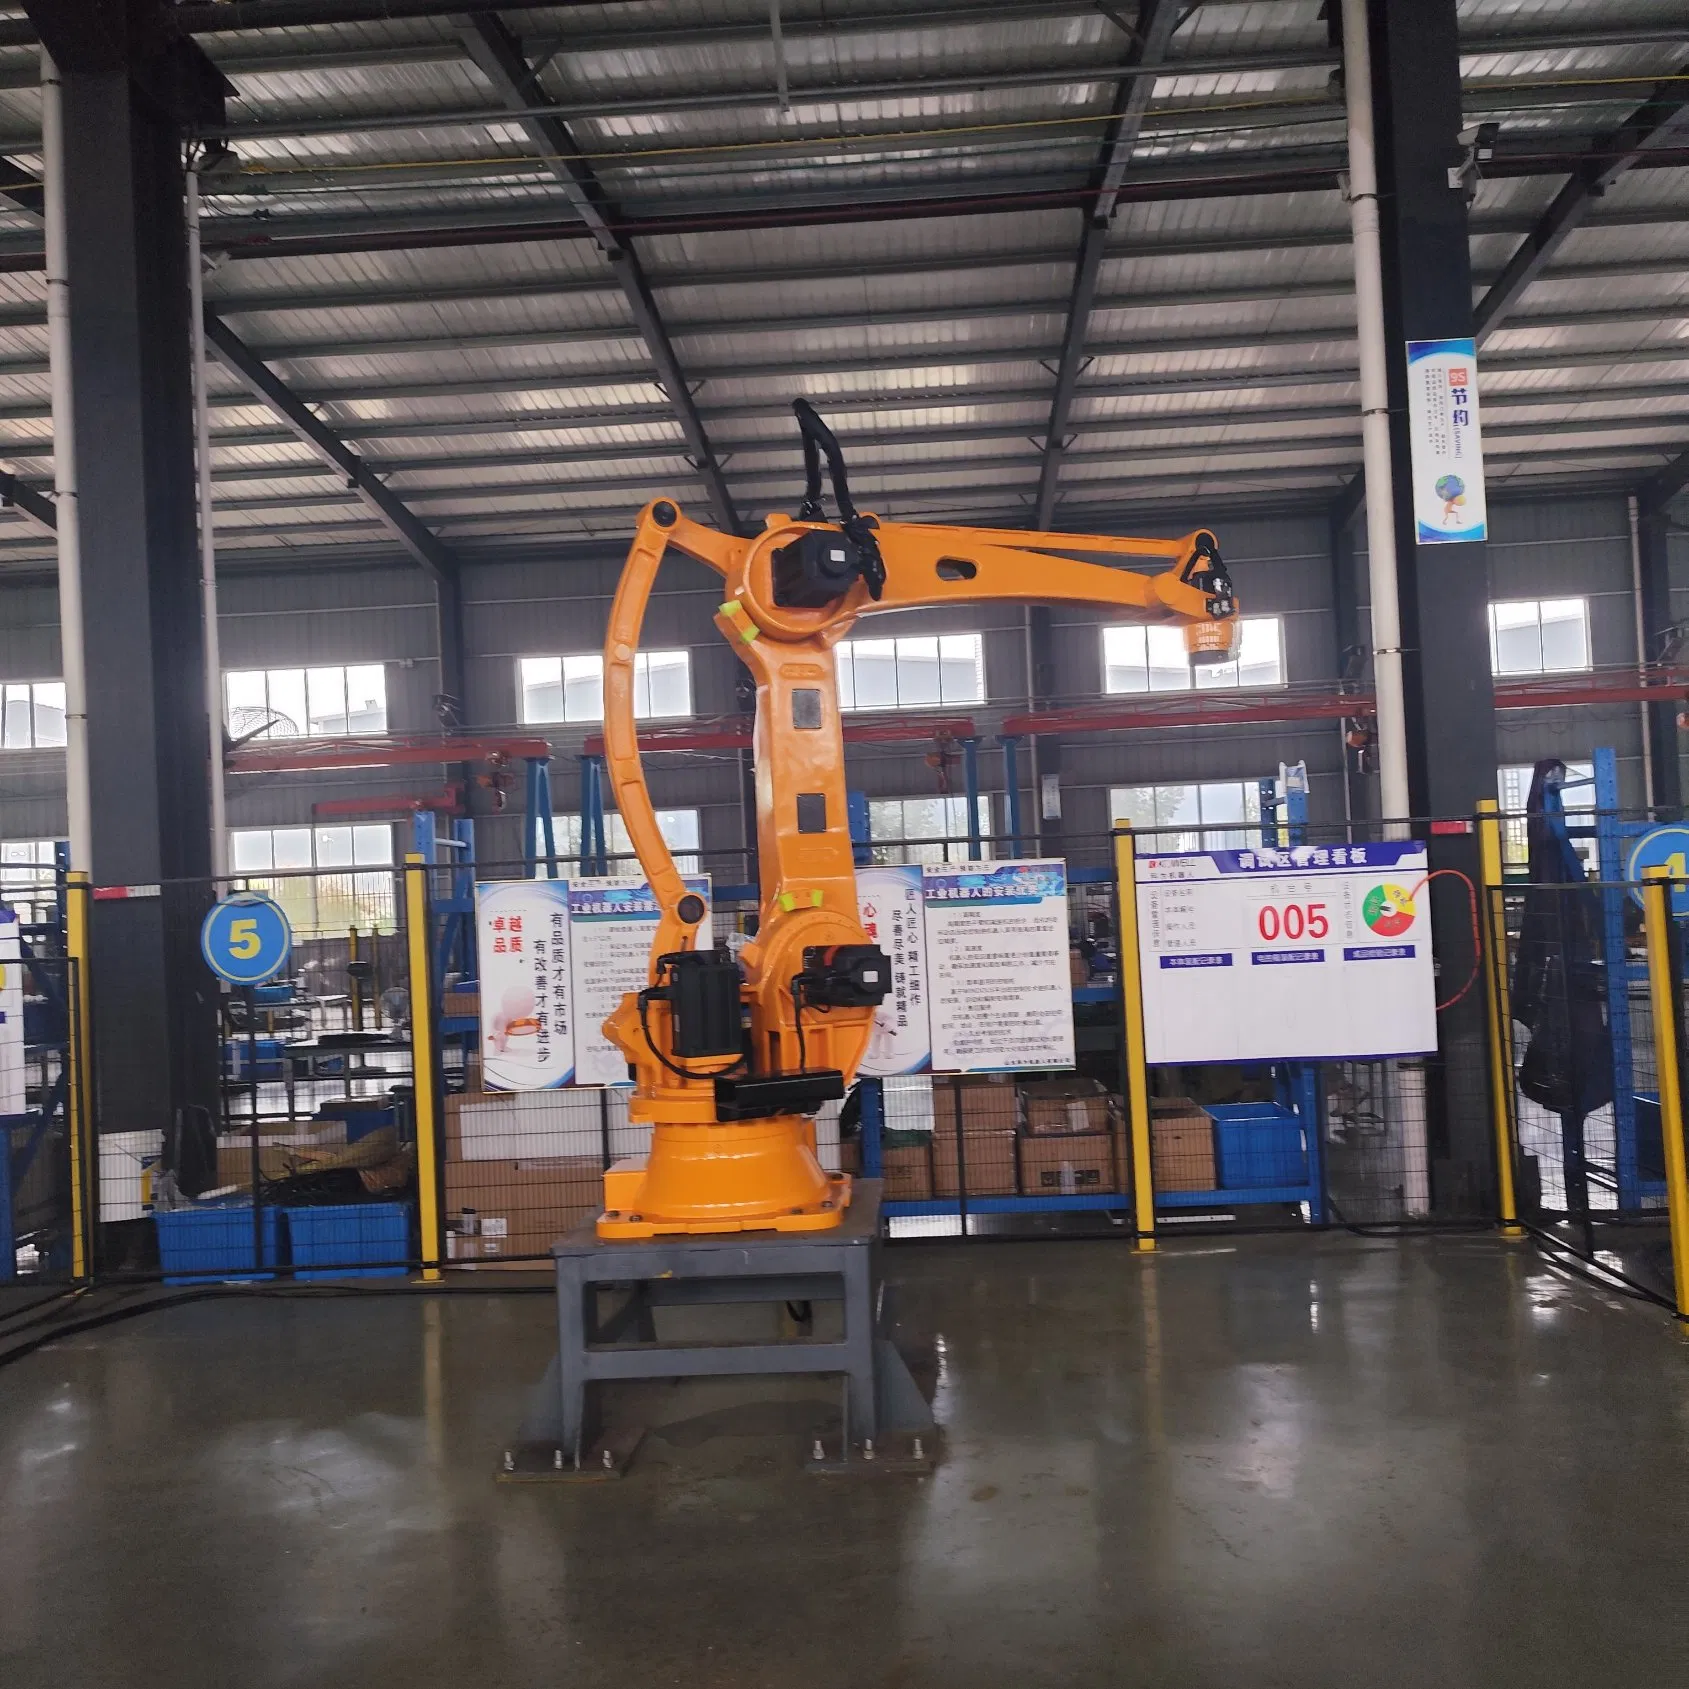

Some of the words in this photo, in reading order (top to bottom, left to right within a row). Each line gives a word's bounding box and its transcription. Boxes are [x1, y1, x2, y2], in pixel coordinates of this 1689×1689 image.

[1451, 388, 1469, 427] 节约
[1239, 848, 1368, 869] 调试区管理看板
[229, 919, 261, 959] 5
[1258, 903, 1329, 941] 005
[493, 936, 524, 953] 品质
[549, 912, 568, 1036] 有品质才有市场
